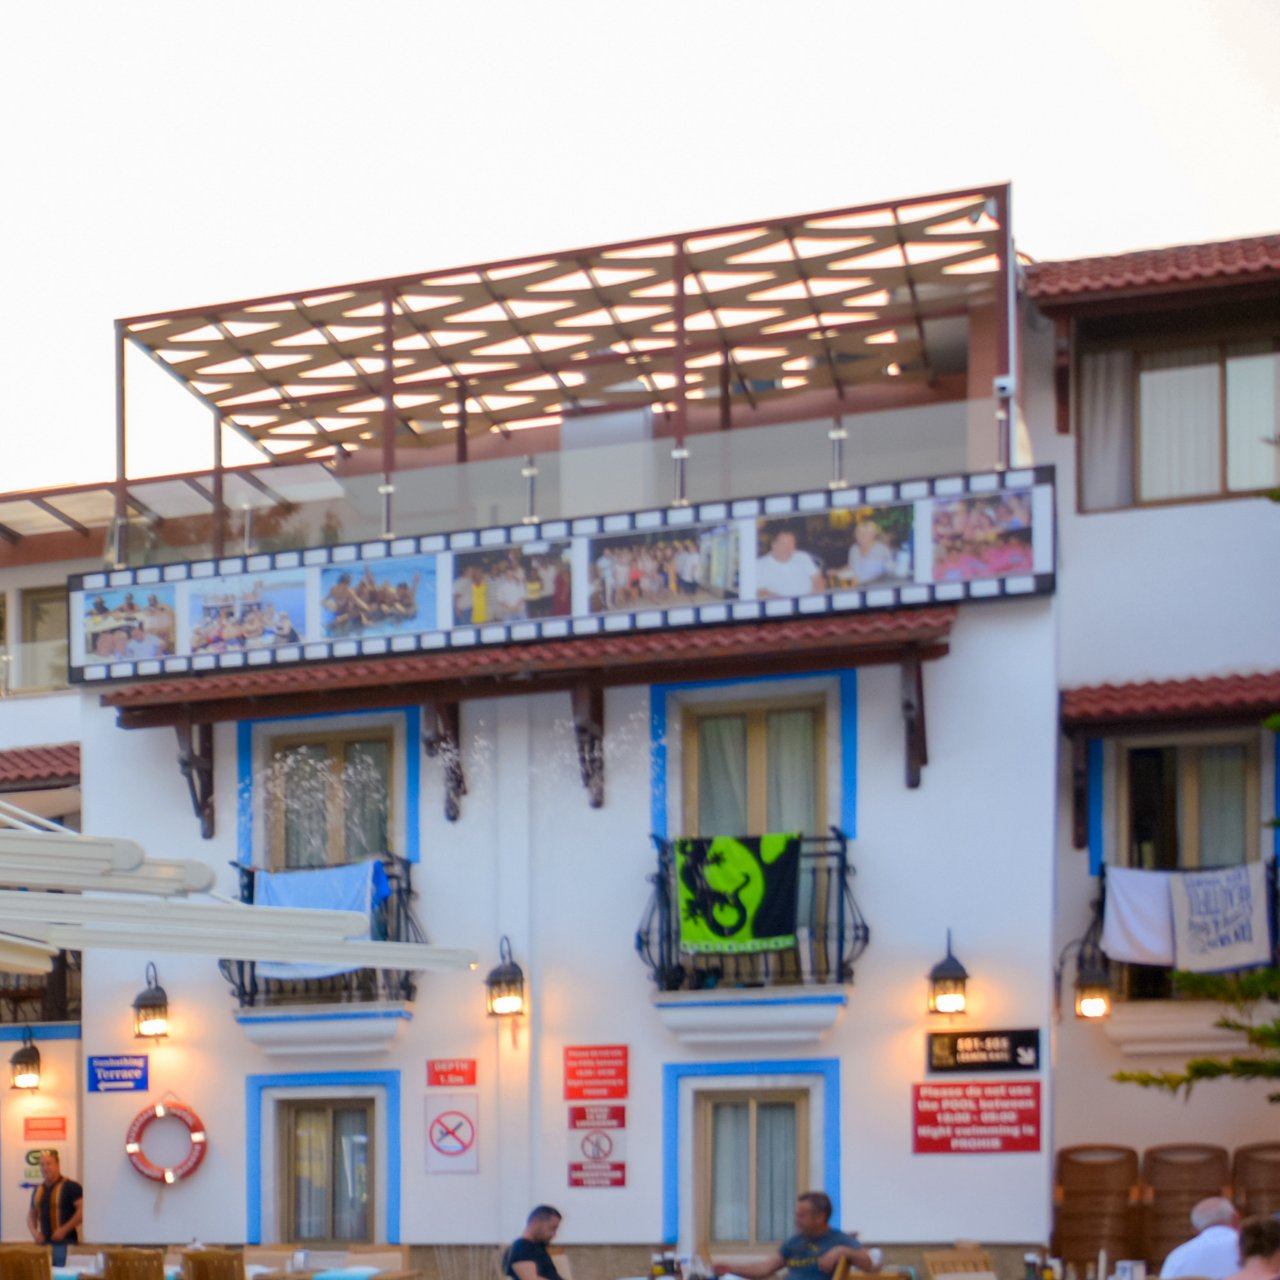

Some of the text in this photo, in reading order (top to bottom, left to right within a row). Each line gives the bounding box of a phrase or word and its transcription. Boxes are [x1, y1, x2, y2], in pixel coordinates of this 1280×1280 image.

[95, 1068, 143, 1080] Terrace
[919, 1085, 1032, 1097] Please do not use
[918, 1098, 1035, 1110] the POOL between
[918, 1125, 1035, 1138] Night swimming is
